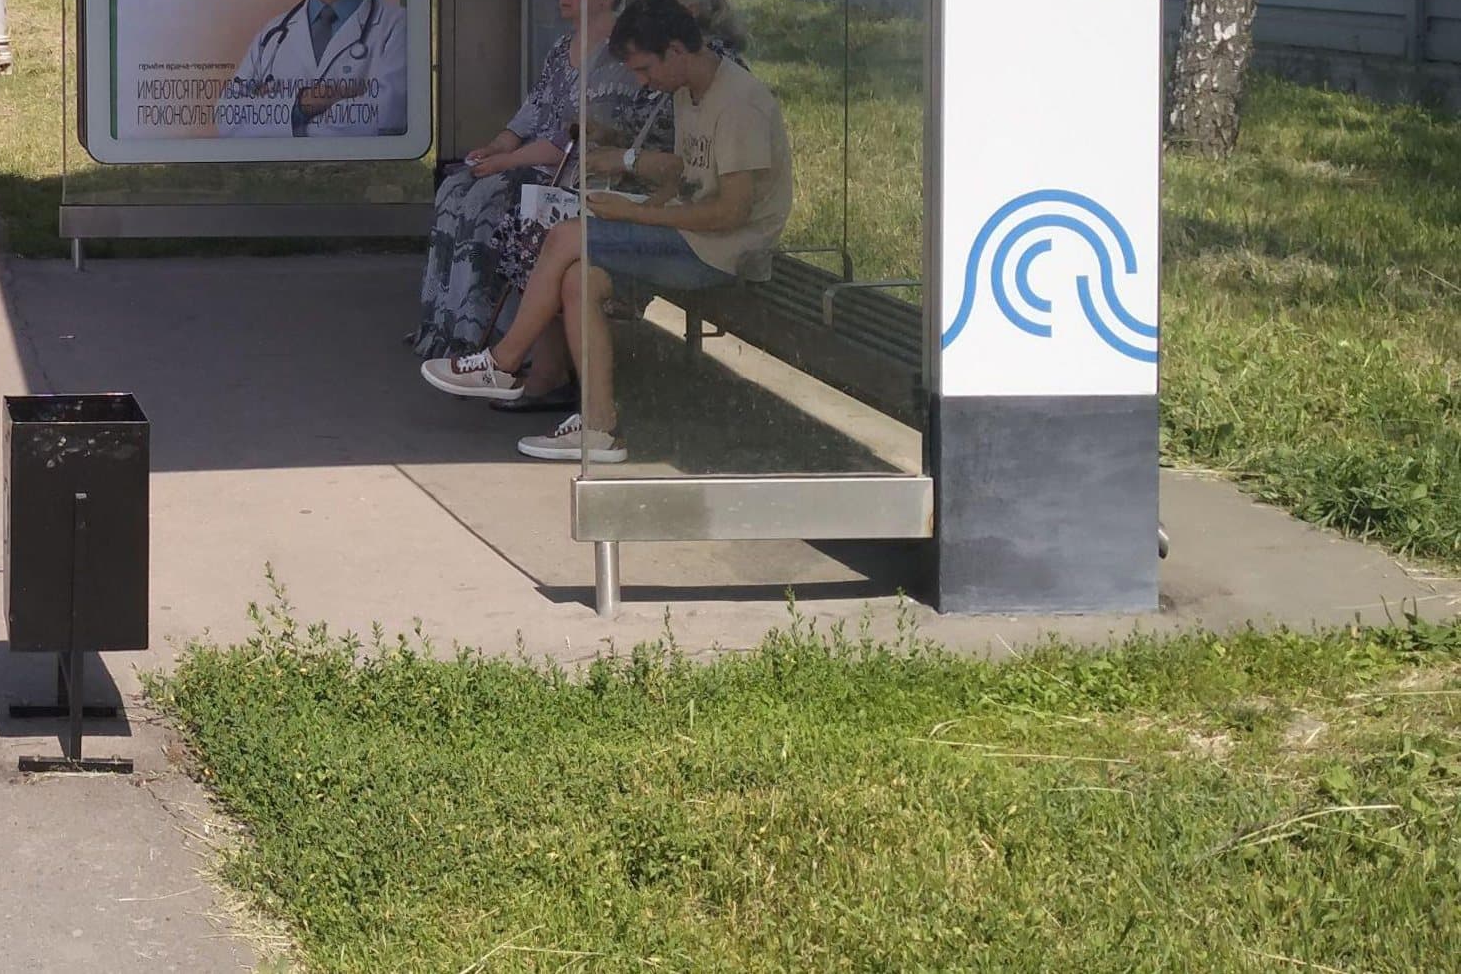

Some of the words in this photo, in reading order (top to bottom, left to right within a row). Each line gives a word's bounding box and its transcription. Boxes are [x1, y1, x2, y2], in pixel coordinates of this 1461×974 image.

[137, 79, 189, 100] ИМЕЮТСЯ
[137, 105, 272, 126] ПРОКОНСУЛЬТИРОВАТЬСЯ
[274, 104, 290, 125] СО
[294, 104, 379, 126] ПЕЦИАЛИСТОМ
